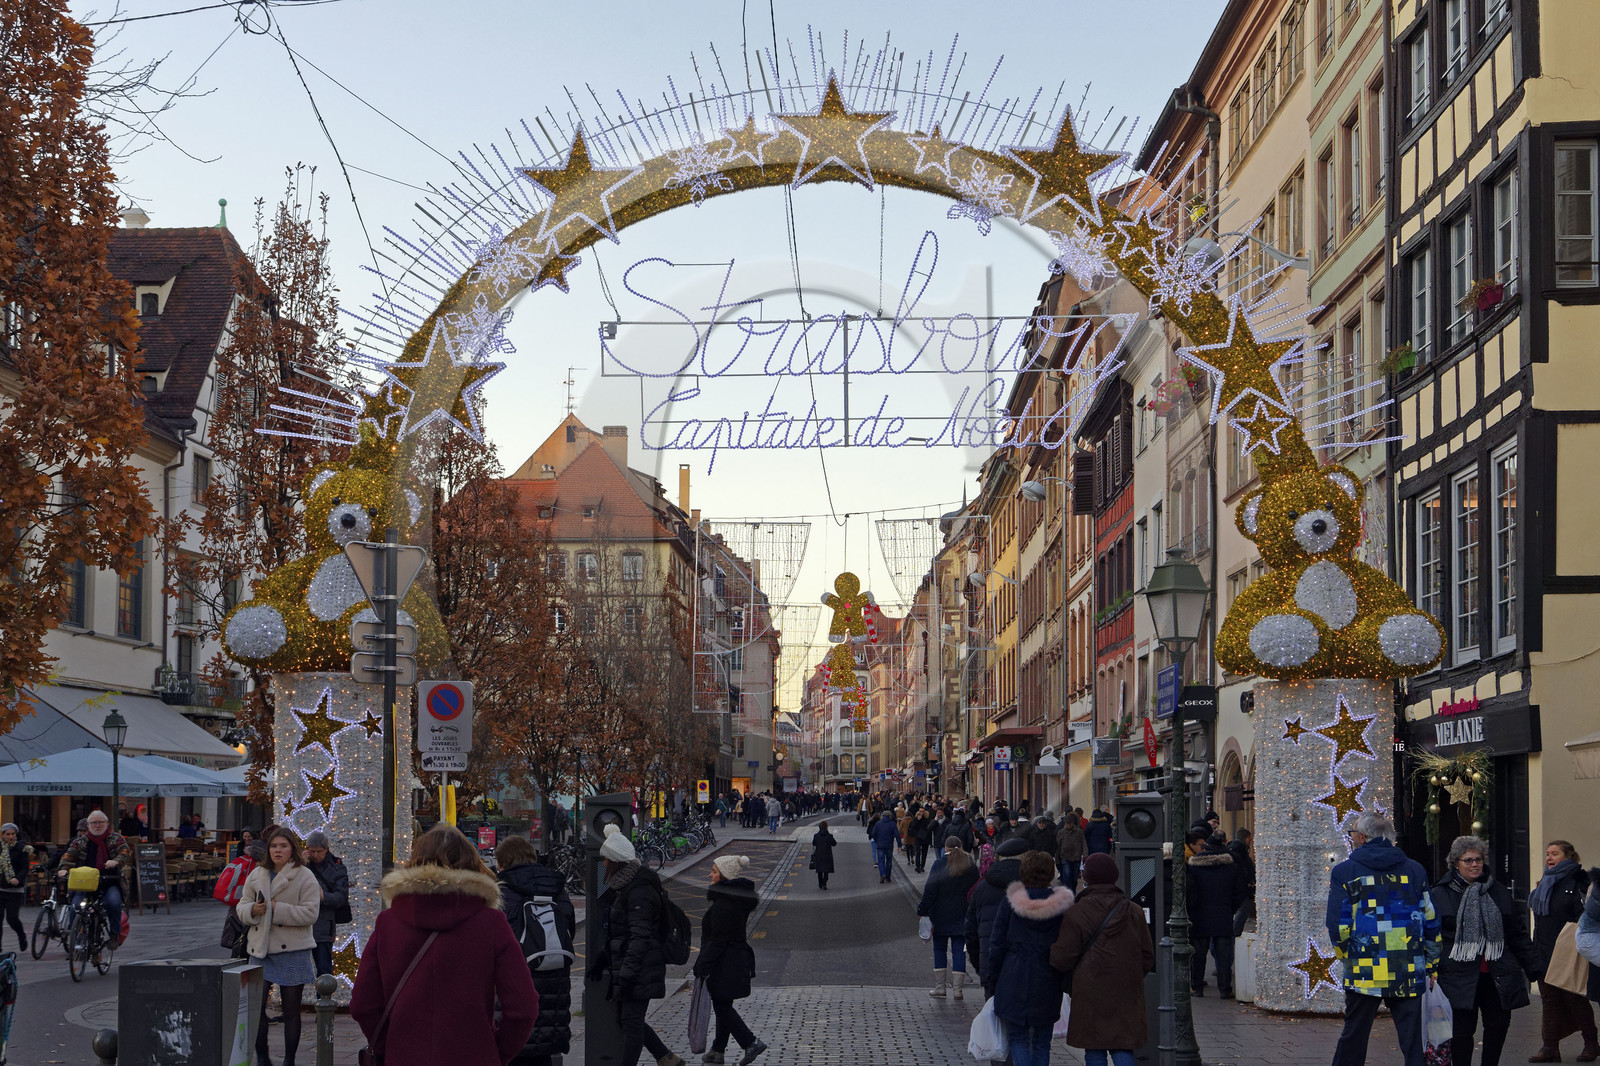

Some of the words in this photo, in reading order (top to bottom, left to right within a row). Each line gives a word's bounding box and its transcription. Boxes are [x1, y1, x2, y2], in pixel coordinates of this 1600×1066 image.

[598, 230, 1140, 450] Strasbourg
[640, 387, 844, 476] Capitale
[854, 394, 909, 449] de
[1147, 727, 1156, 758] TABAC
